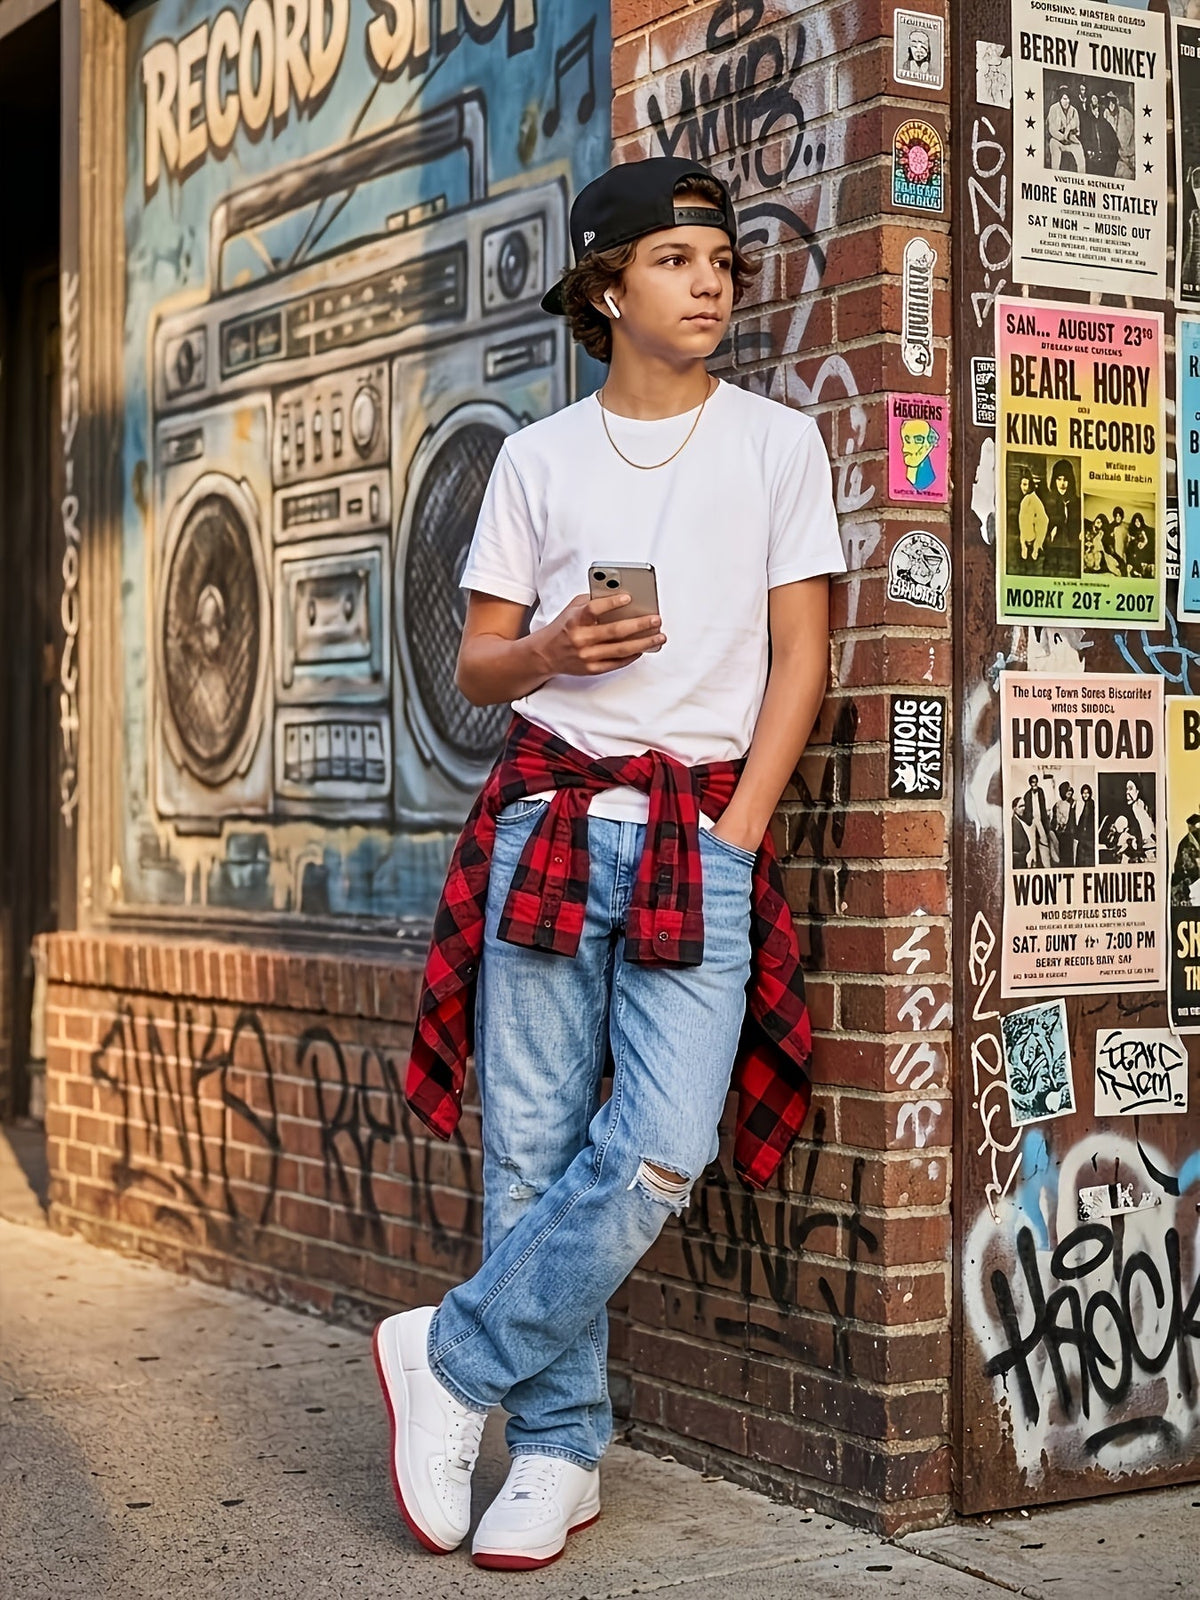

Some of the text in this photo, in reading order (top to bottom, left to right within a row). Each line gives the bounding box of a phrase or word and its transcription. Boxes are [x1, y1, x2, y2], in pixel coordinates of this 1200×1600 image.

[1020, 31, 1157, 80] BERRY TONKEY
[142, 0, 350, 190] RECORD
[1021, 182, 1057, 204] MORE
[1063, 188, 1097, 209] GARN
[1102, 193, 1158, 217] STTATLEY
[1028, 214, 1048, 227] SAT
[1094, 222, 1127, 237] MUSIC
[1131, 227, 1152, 240] OUT
[1057, 318, 1116, 344] AUGUST
[1010, 353, 1082, 402] BEARL
[1093, 362, 1151, 408] HORY
[1006, 412, 1058, 447] KING
[1115, 593, 1155, 613] 2007
[1012, 685, 1029, 698] The
[1012, 718, 1154, 759] HORTOAD
[1013, 873, 1075, 906] WON'T
[1013, 935, 1041, 953] SAT.
[1105, 932, 1133, 950] 7:00
[1137, 931, 1155, 948] PM
